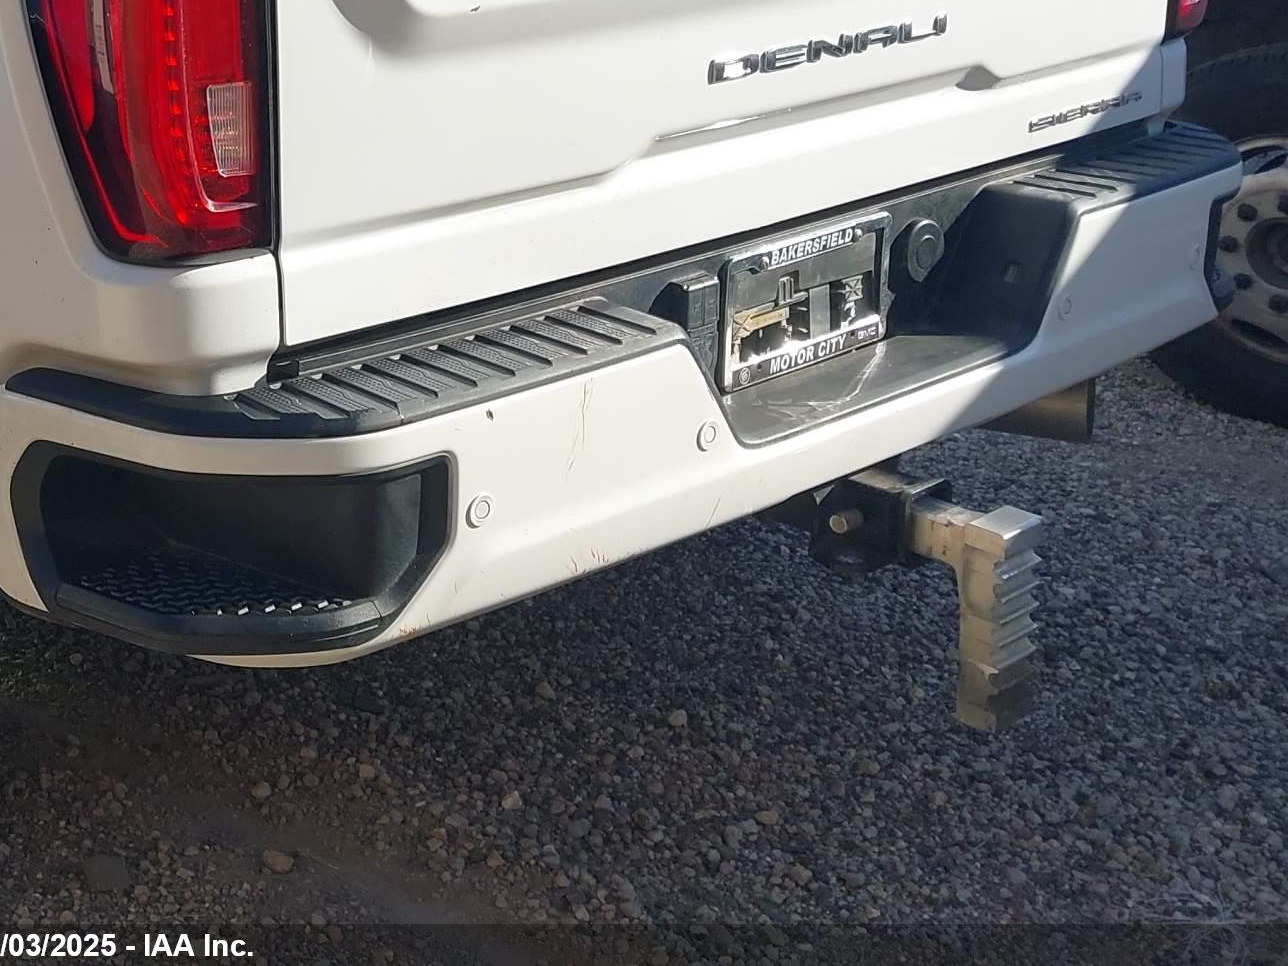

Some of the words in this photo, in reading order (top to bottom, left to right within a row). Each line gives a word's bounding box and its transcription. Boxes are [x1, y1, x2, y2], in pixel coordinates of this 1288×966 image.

[708, 11, 948, 85] DENALI
[1028, 92, 1142, 133] SIERRA
[771, 228, 853, 265] BAKERSFIELD
[770, 345, 815, 375] MOTOR
[818, 333, 847, 357] CITY
